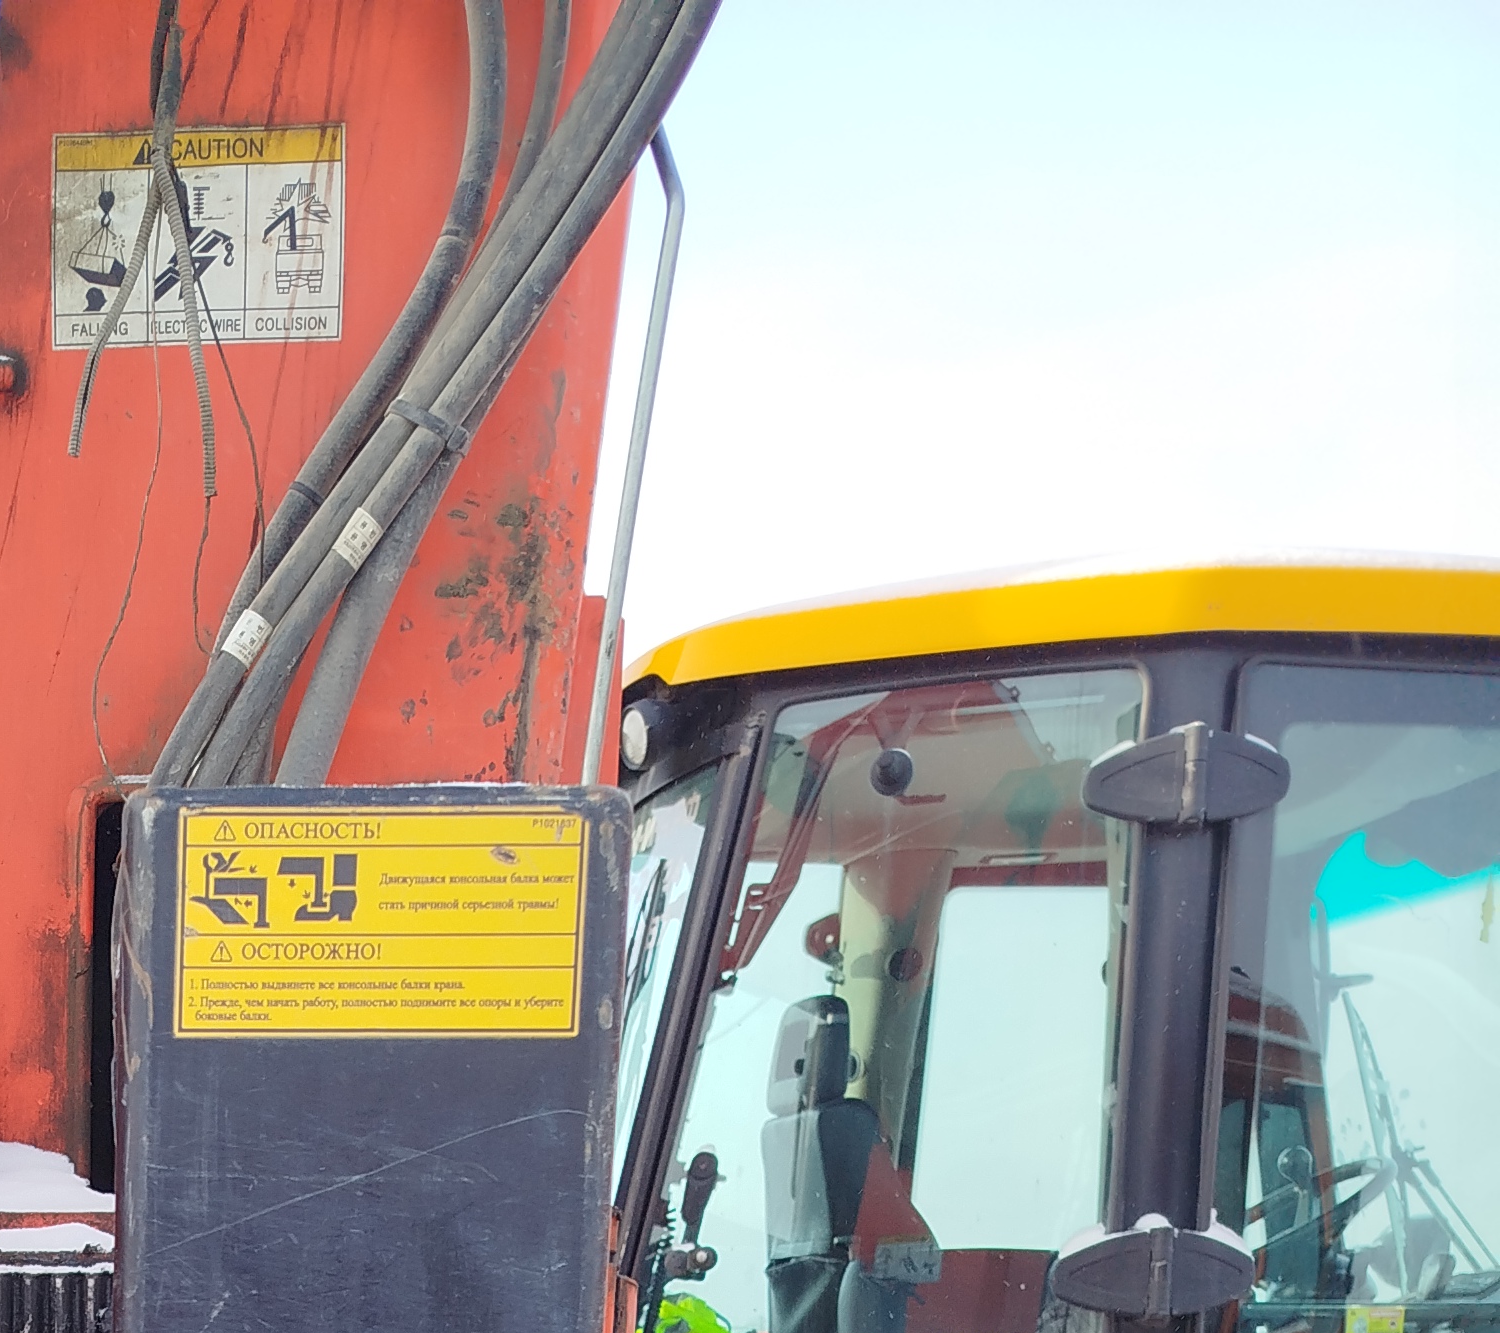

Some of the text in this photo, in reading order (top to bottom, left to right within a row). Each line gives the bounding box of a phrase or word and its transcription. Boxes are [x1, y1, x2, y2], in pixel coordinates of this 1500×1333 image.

[170, 137, 264, 161] CAUTION
[71, 321, 129, 337] FALNG
[150, 318, 242, 335] ELECTC WIRE
[255, 316, 328, 332] COLLISION
[244, 821, 382, 840] ОПАСНОСТЬ!
[449, 874, 507, 885] консольная
[510, 873, 539, 884] балка
[542, 874, 575, 884] может
[378, 901, 405, 910] стать
[409, 899, 459, 912] причиной
[242, 942, 382, 961] ОСТОРОЖНО!
[190, 979, 198, 990] 1.
[201, 979, 258, 990] Полностью
[318, 982, 335, 990] все
[338, 981, 398, 990] консольные
[400, 978, 430, 990] балки
[188, 996, 198, 1007] 2.
[200, 996, 242, 1010] Прежде,
[245, 999, 263, 1007] чем
[302, 997, 339, 1010] работу,
[341, 999, 398, 1008] полностью
[459, 999, 476, 1007] все
[478, 999, 512, 1010] опоры
[195, 1010, 237, 1021] боковые
